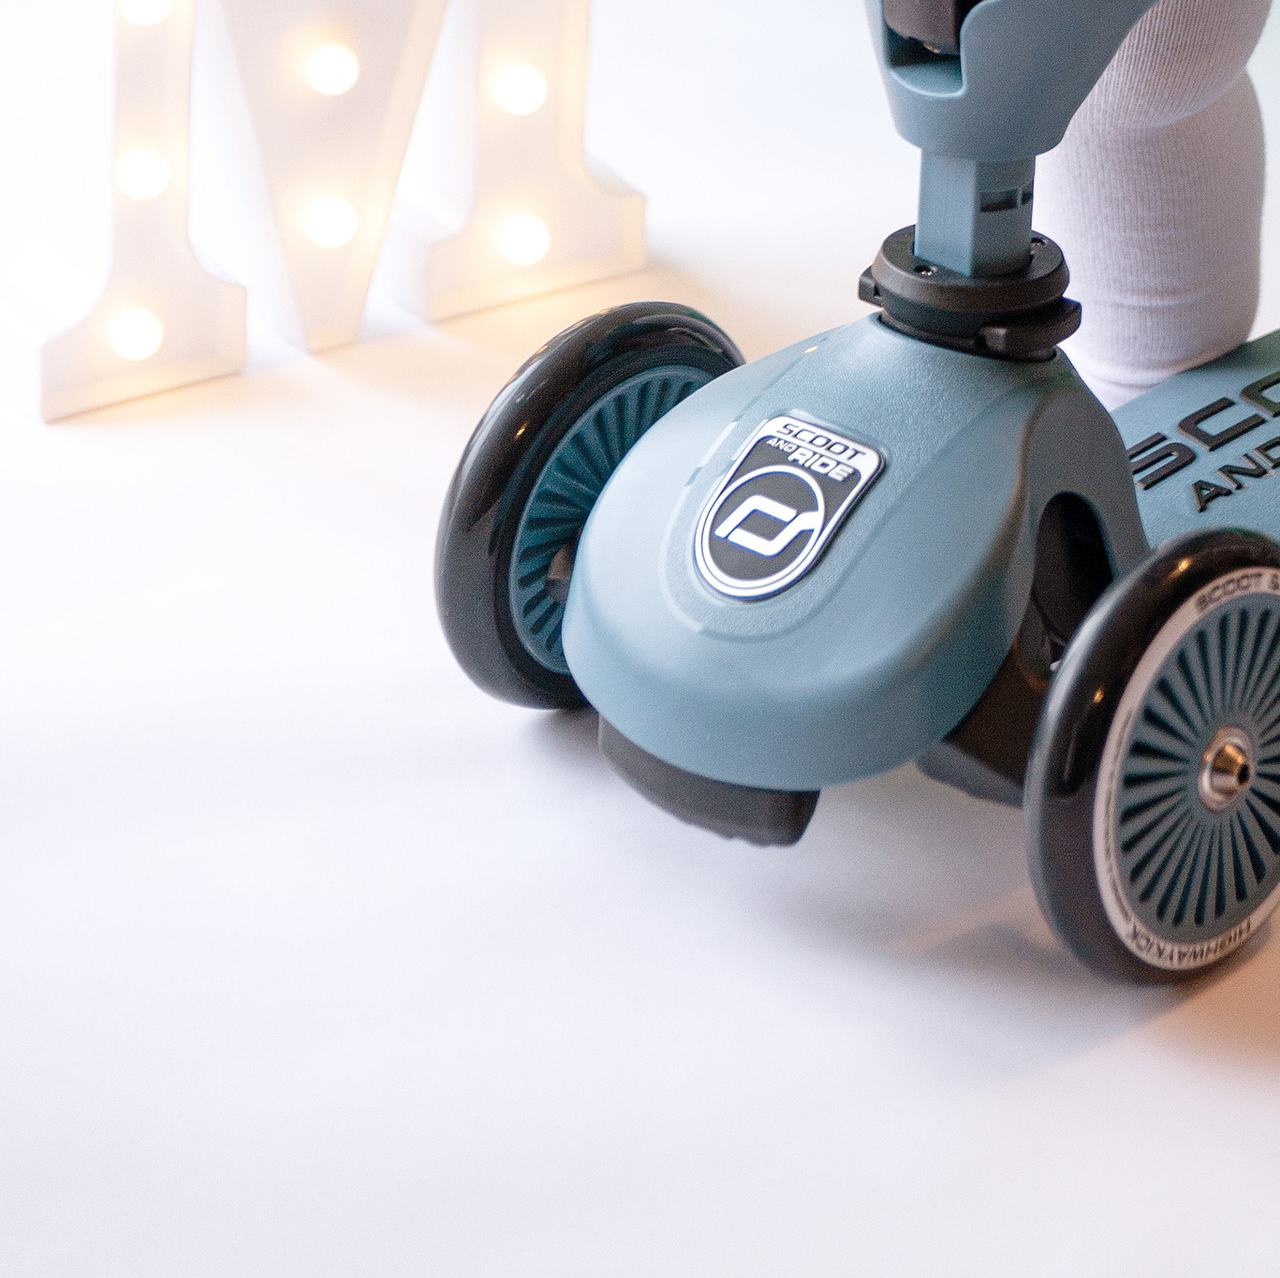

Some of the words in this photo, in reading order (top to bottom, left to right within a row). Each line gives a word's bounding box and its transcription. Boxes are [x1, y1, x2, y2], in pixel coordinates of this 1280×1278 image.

[765, 436, 798, 454] AND
[787, 447, 855, 482] RIDE
[776, 422, 866, 461] SCOOT
[1195, 572, 1262, 612] SCOOT
